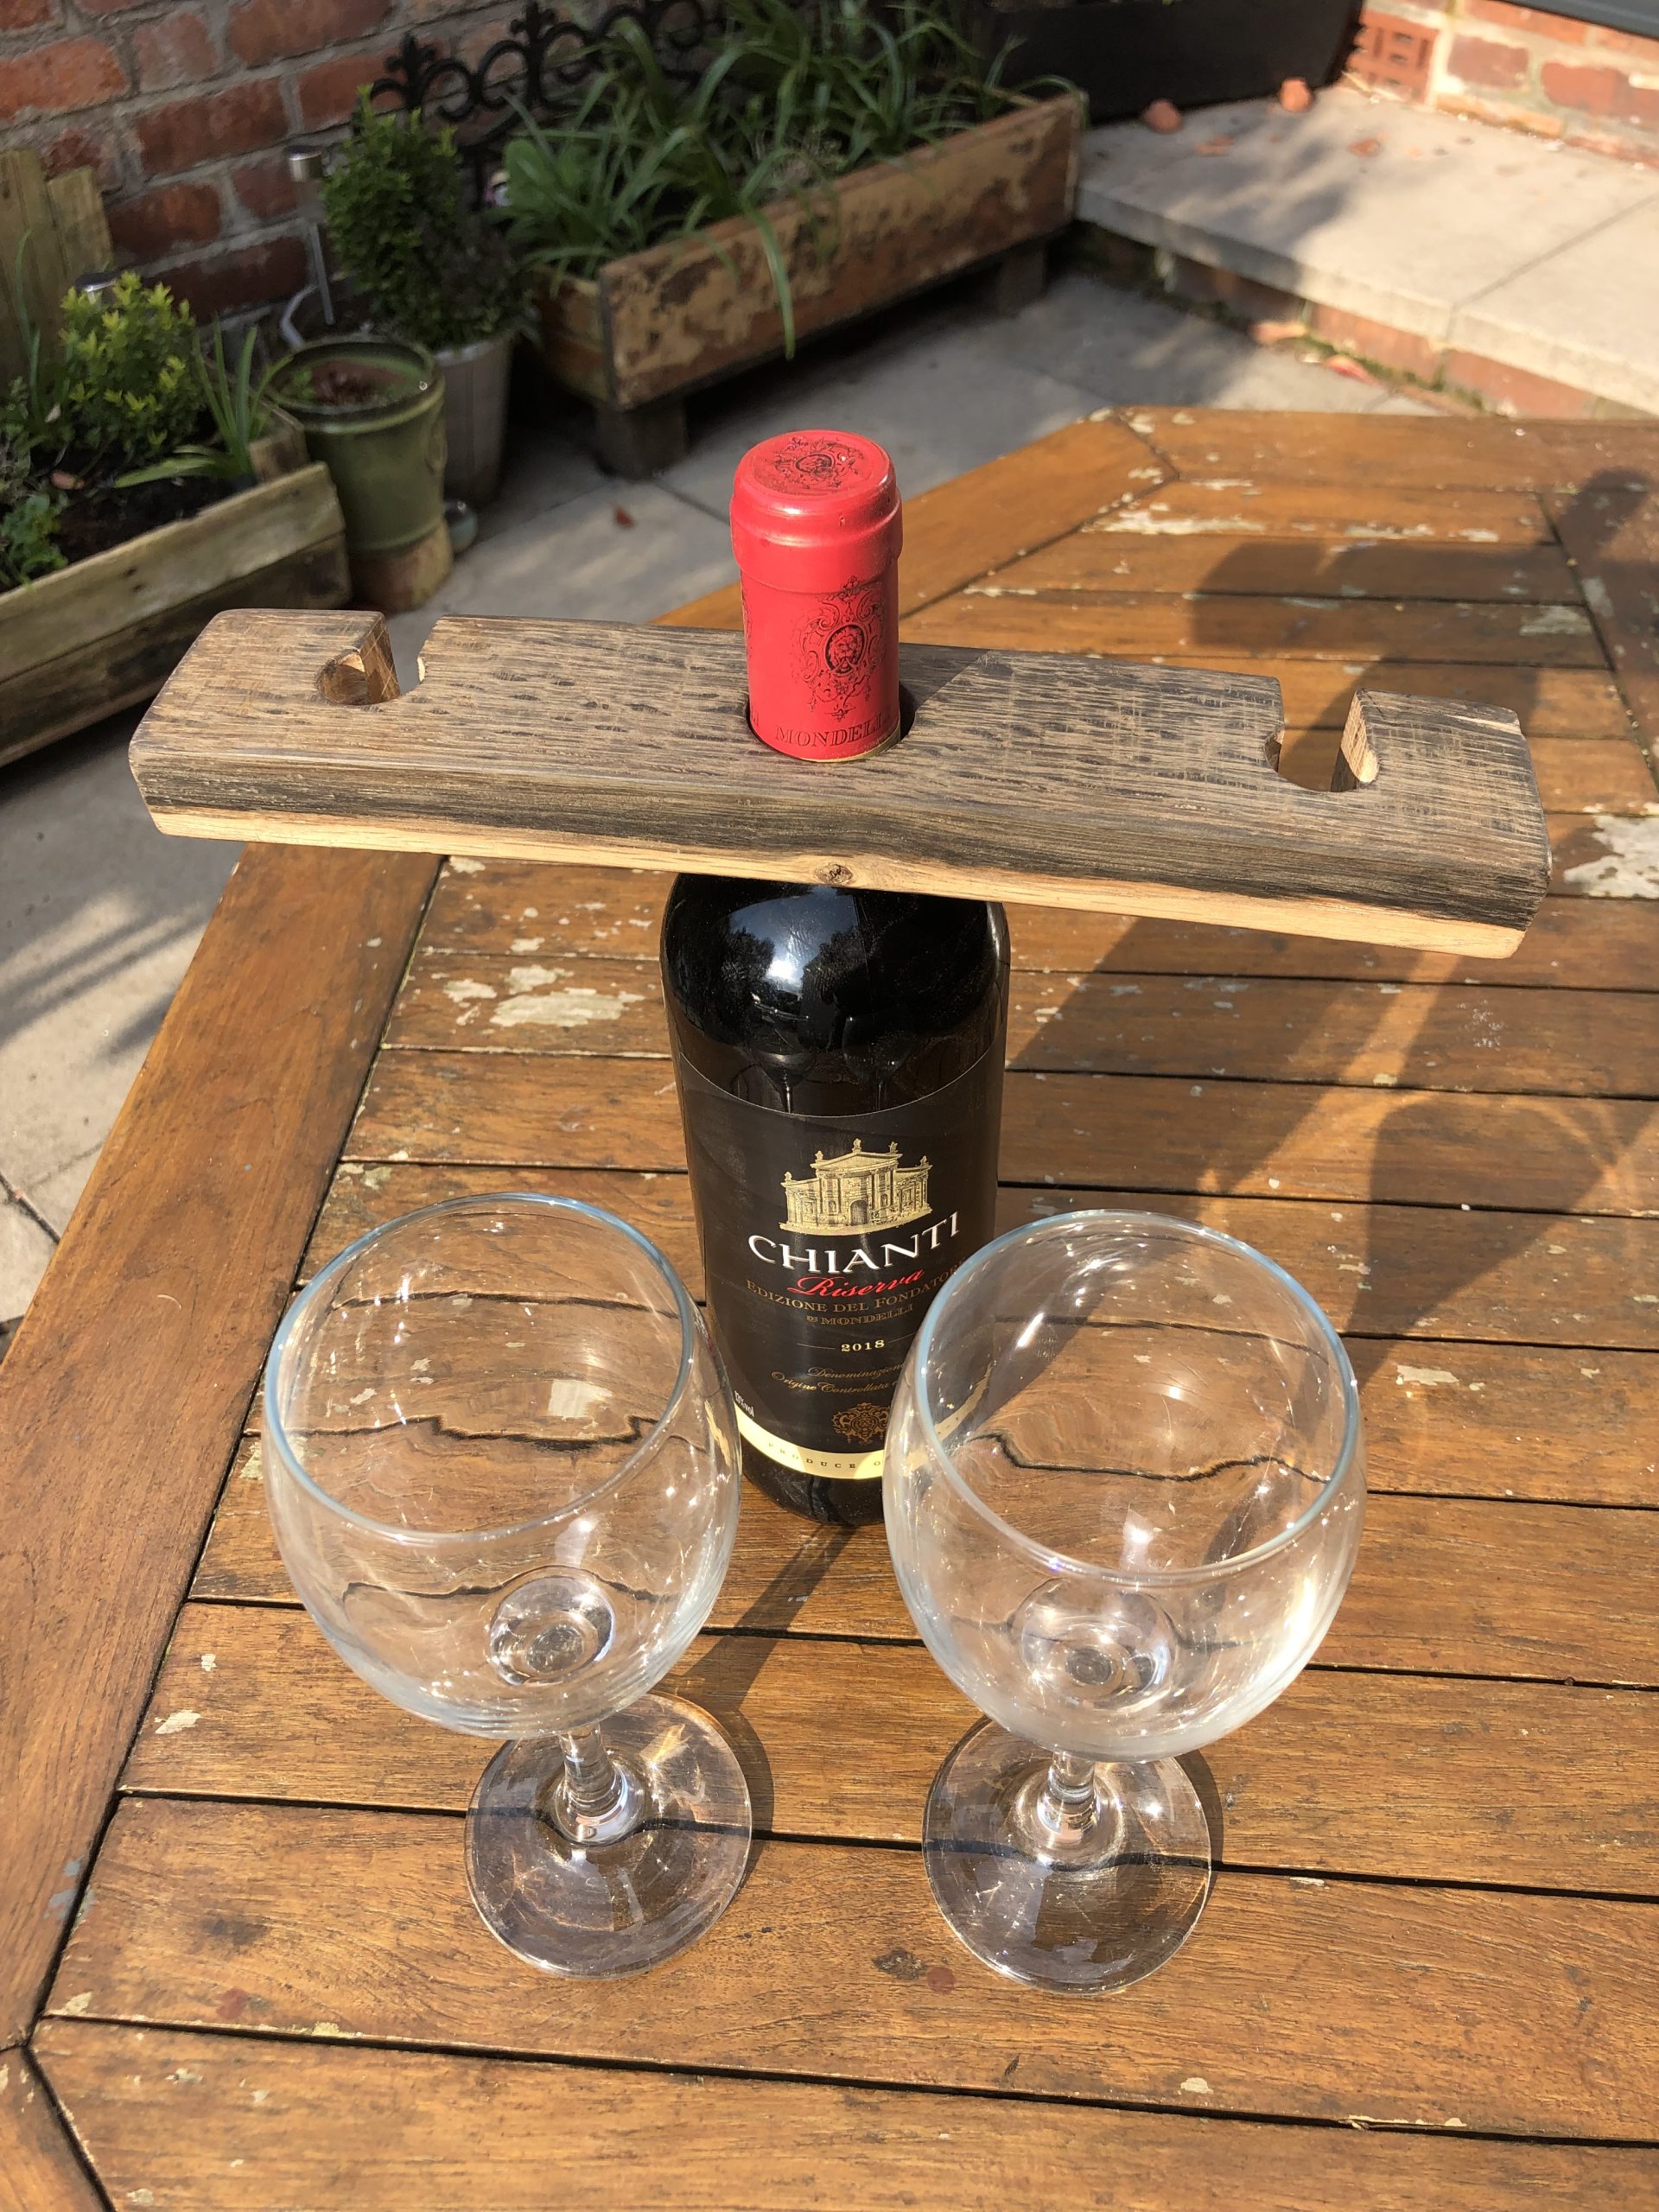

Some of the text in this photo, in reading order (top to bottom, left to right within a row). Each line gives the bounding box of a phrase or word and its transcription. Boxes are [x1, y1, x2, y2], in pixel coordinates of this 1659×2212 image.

[747, 1211, 961, 1274] CHIANTI
[746, 1279, 828, 1313] EDIZIONE
[832, 1302, 869, 1313] DEL
[787, 1268, 925, 1298] Riserva
[821, 1303, 913, 1325] MONDELLI
[841, 1339, 885, 1352] 2018
[771, 1371, 817, 1391] Origine
[817, 1381, 890, 1394] Controllata
